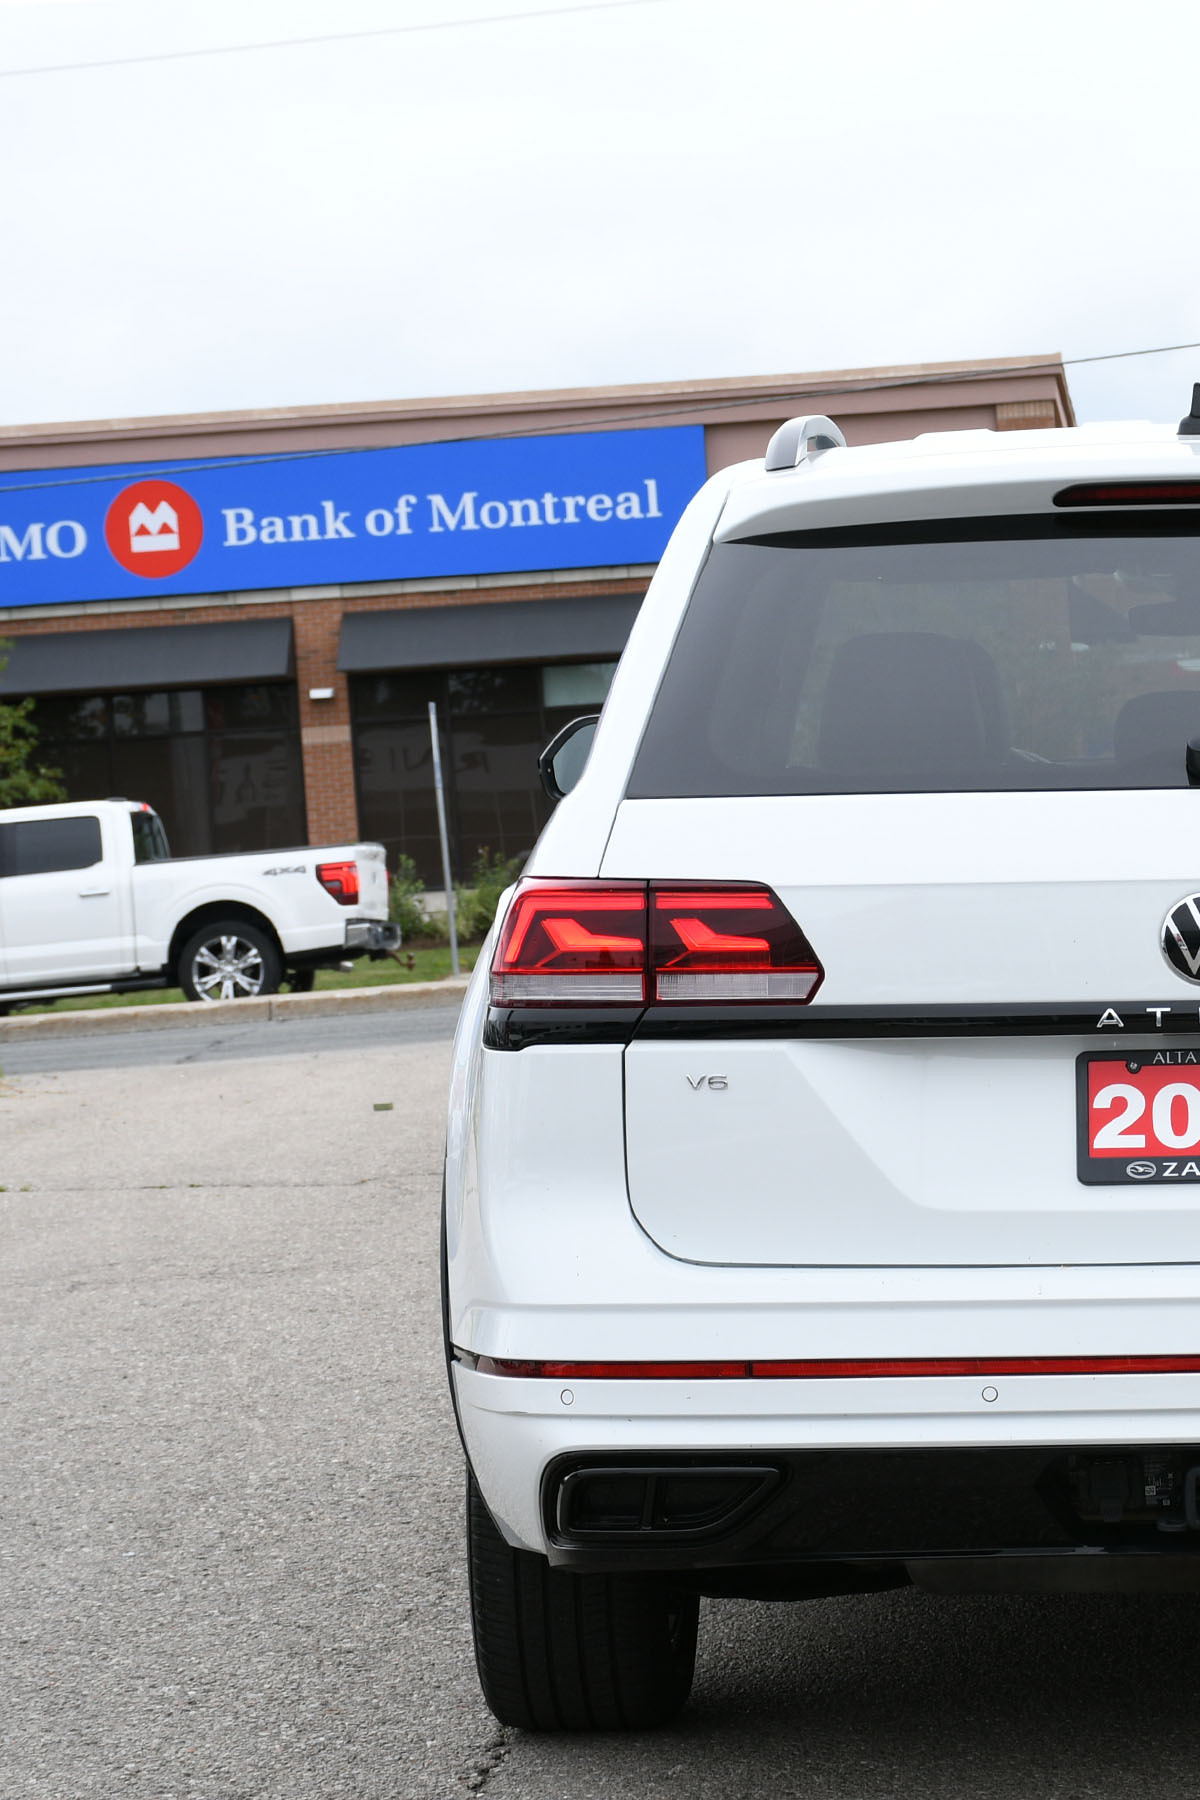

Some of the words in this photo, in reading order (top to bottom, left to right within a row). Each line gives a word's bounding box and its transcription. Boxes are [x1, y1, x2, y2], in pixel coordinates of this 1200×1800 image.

[222, 500, 356, 547] Bank
[365, 495, 417, 537] of
[427, 479, 662, 532] Montreal
[1152, 1050, 1197, 1065] ALTA
[685, 1073, 728, 1091] V6
